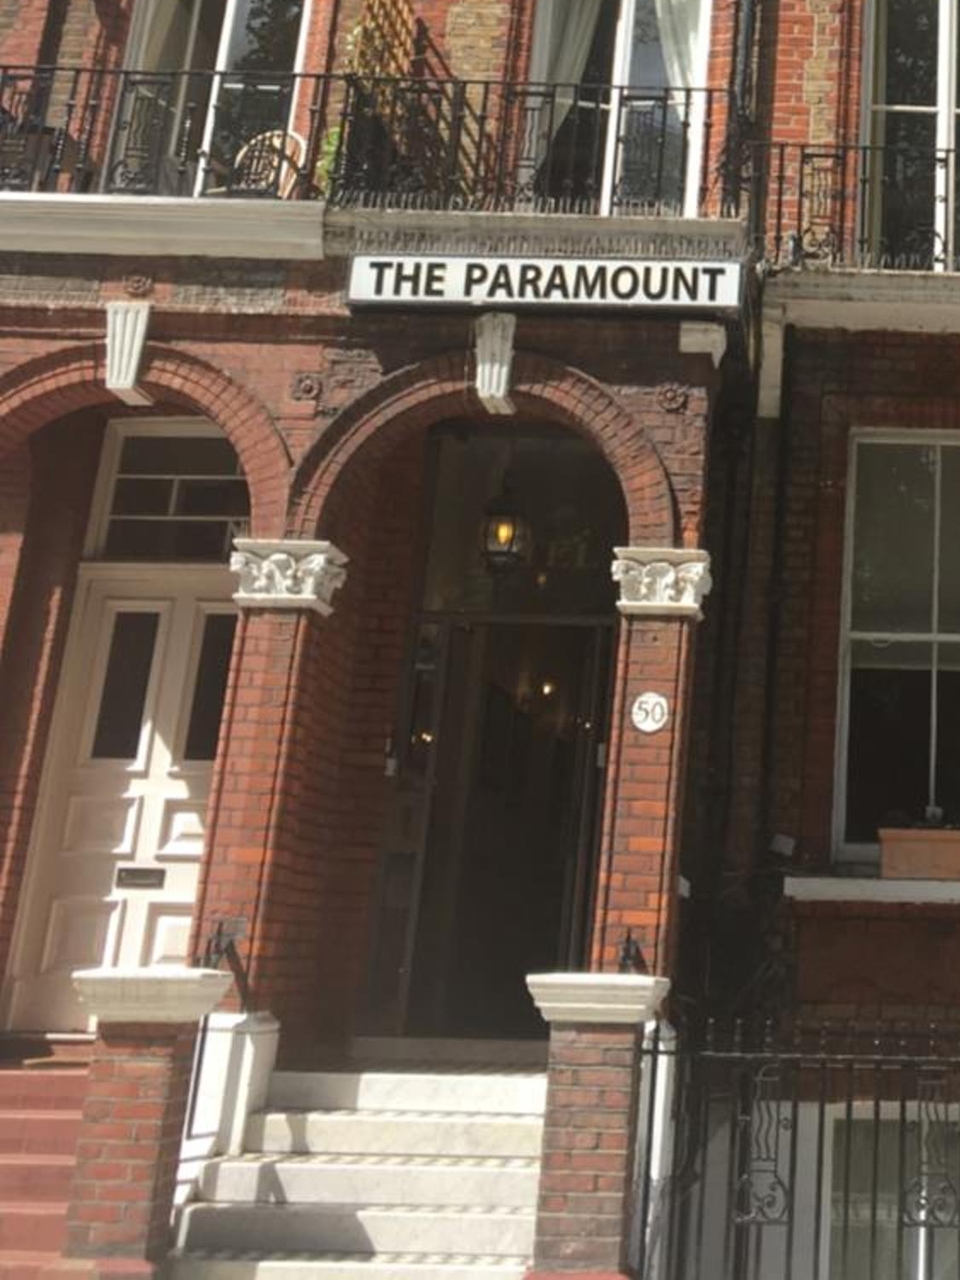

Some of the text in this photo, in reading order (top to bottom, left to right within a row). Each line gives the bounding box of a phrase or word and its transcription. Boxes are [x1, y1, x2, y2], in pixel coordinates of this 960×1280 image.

[369, 261, 725, 302] THE PARAMOUNT
[637, 700, 665, 724] 50
